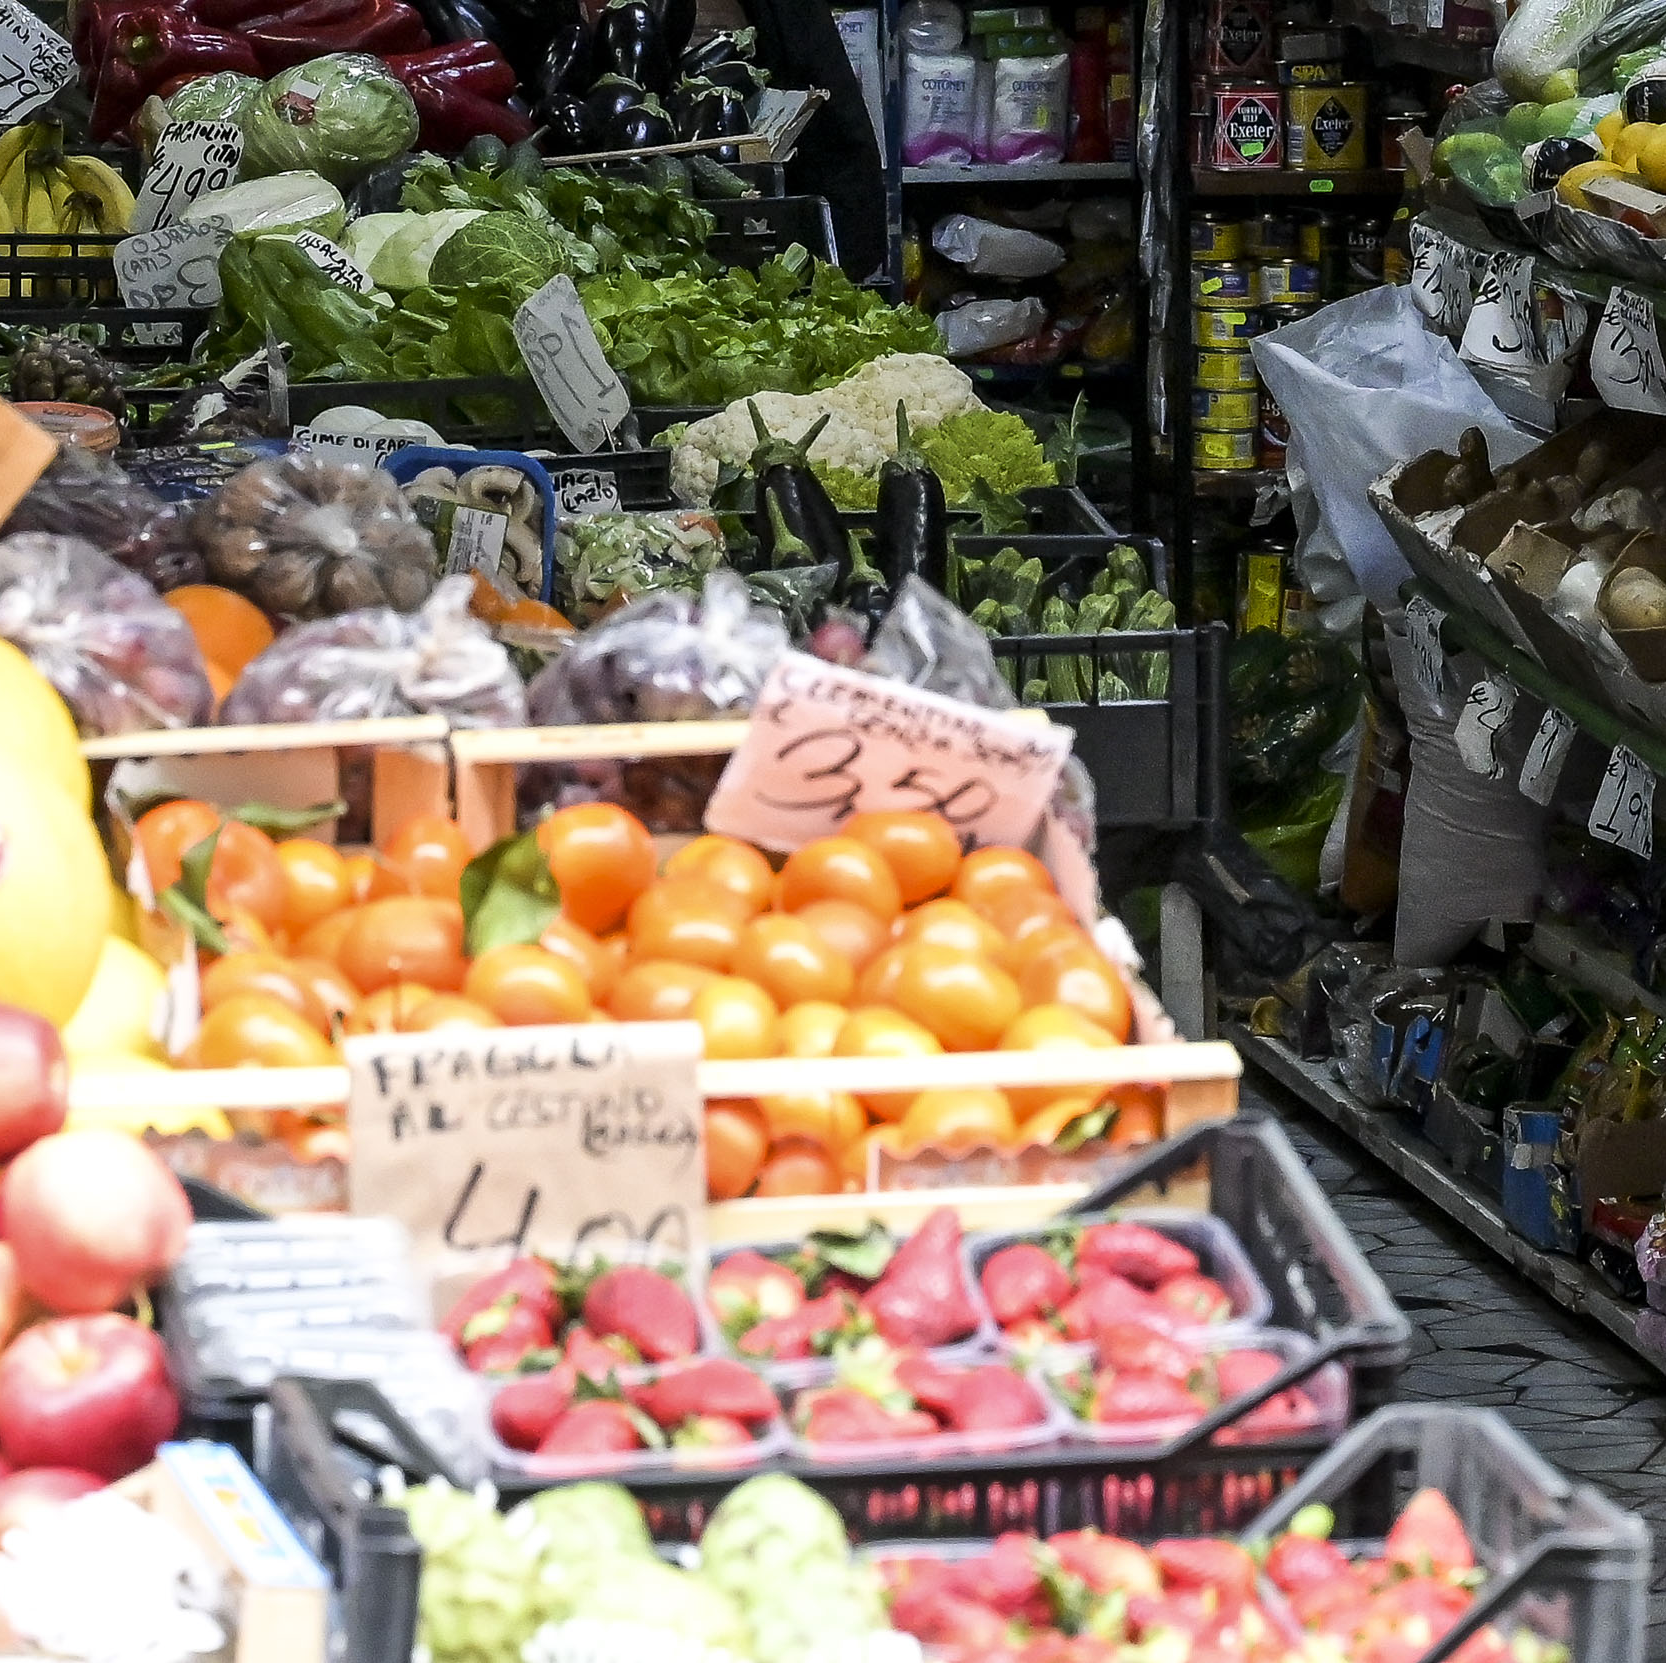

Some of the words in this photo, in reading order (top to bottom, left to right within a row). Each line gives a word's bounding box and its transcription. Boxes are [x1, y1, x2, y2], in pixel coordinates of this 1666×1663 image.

[161, 121, 239, 143] FAGIOLINI
[1229, 121, 1274, 139] Exeter
[1314, 116, 1353, 132] Exeter
[352, 437, 370, 449] DI
